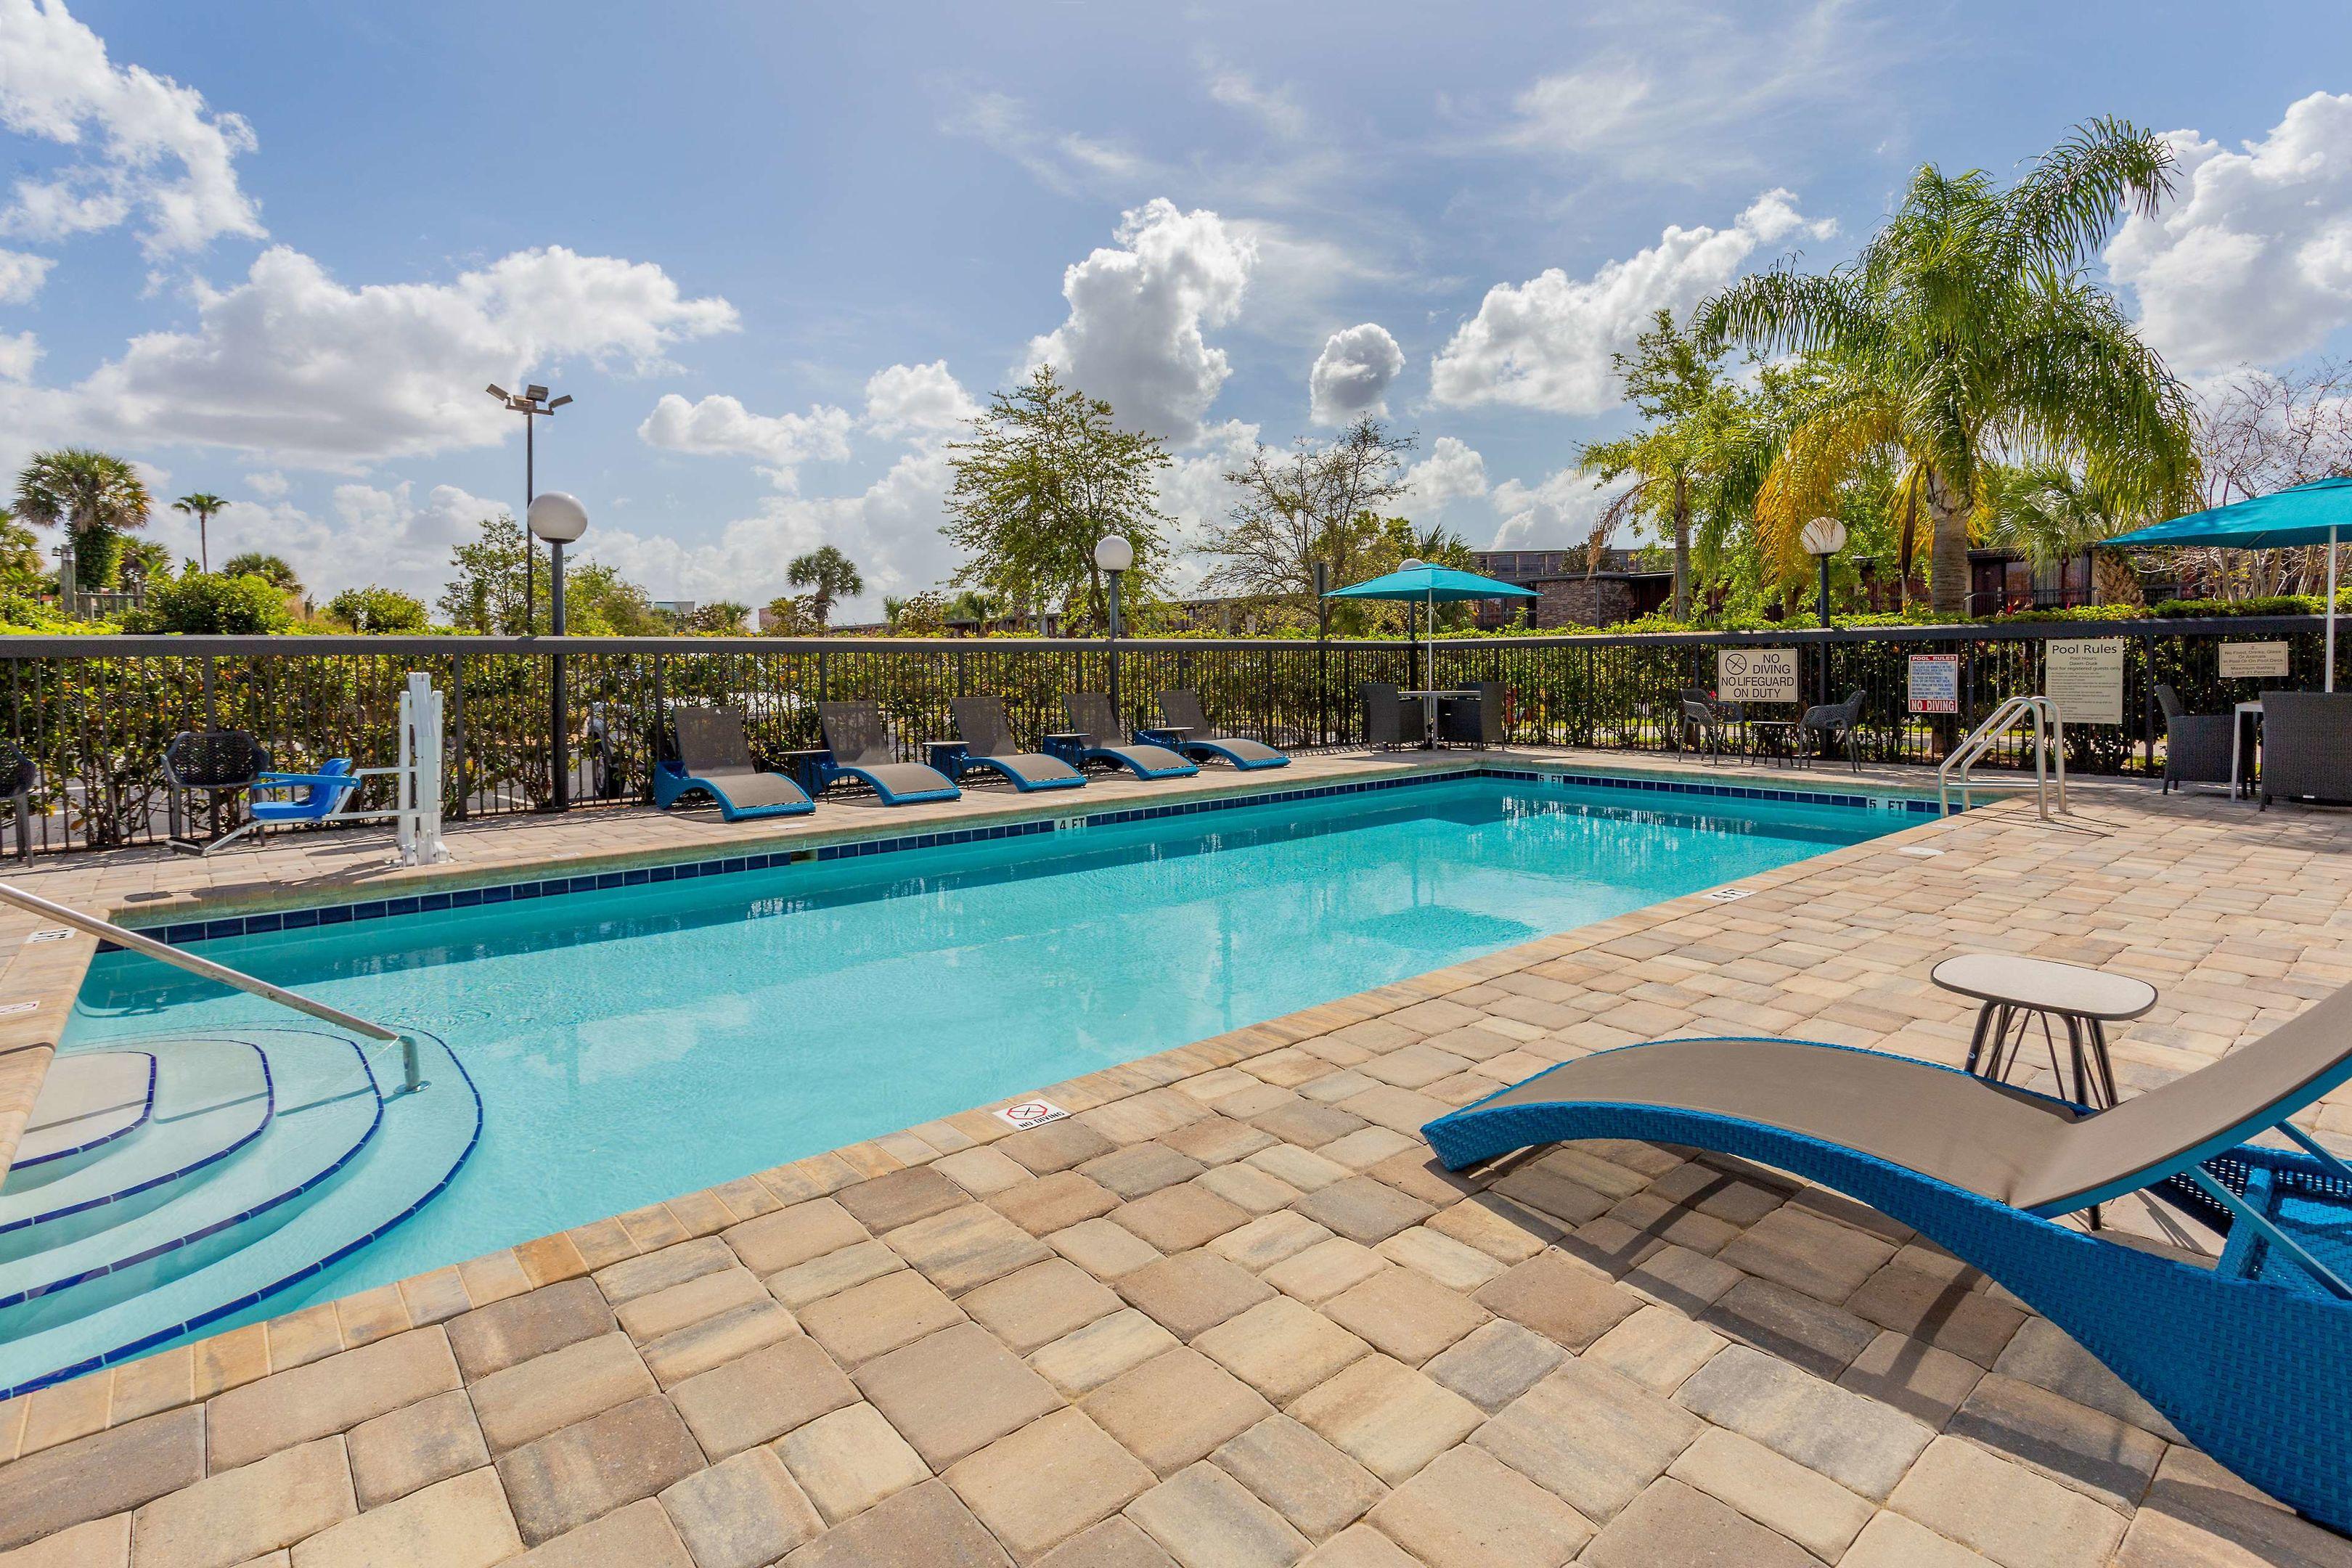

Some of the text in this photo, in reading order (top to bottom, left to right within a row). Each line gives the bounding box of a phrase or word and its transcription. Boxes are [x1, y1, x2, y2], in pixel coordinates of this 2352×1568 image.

[2053, 645, 2117, 653] Pool Rules
[1763, 654, 1779, 663] NO
[1753, 664, 1790, 674] DIVING
[1722, 677, 1794, 686] NO LIFEGUARD
[1734, 688, 1781, 698] ON DUTY
[1911, 700, 1954, 711] NO DIVING
[1869, 799, 1903, 810] 5 FT
[1060, 817, 1085, 830] 4 FT
[1034, 1111, 1065, 1123] DIVING
